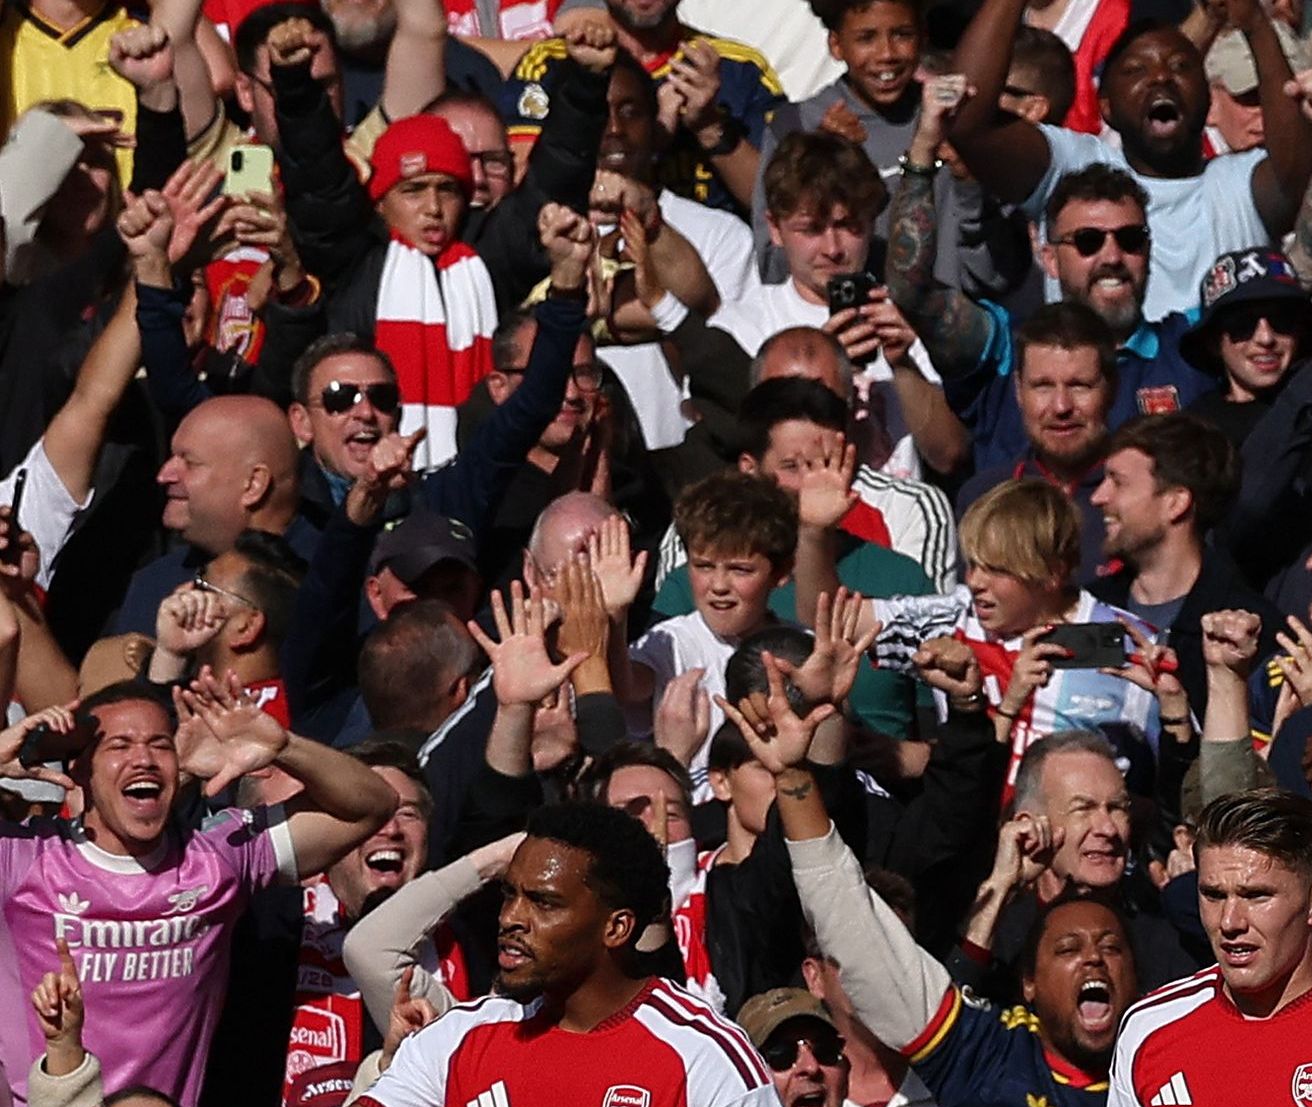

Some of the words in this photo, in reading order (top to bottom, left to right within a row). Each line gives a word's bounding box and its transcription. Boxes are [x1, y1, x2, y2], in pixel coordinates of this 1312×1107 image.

[80, 953, 118, 982] FLY
[122, 948, 194, 982] BETTER
[611, 1092, 643, 1105] Arsenal
